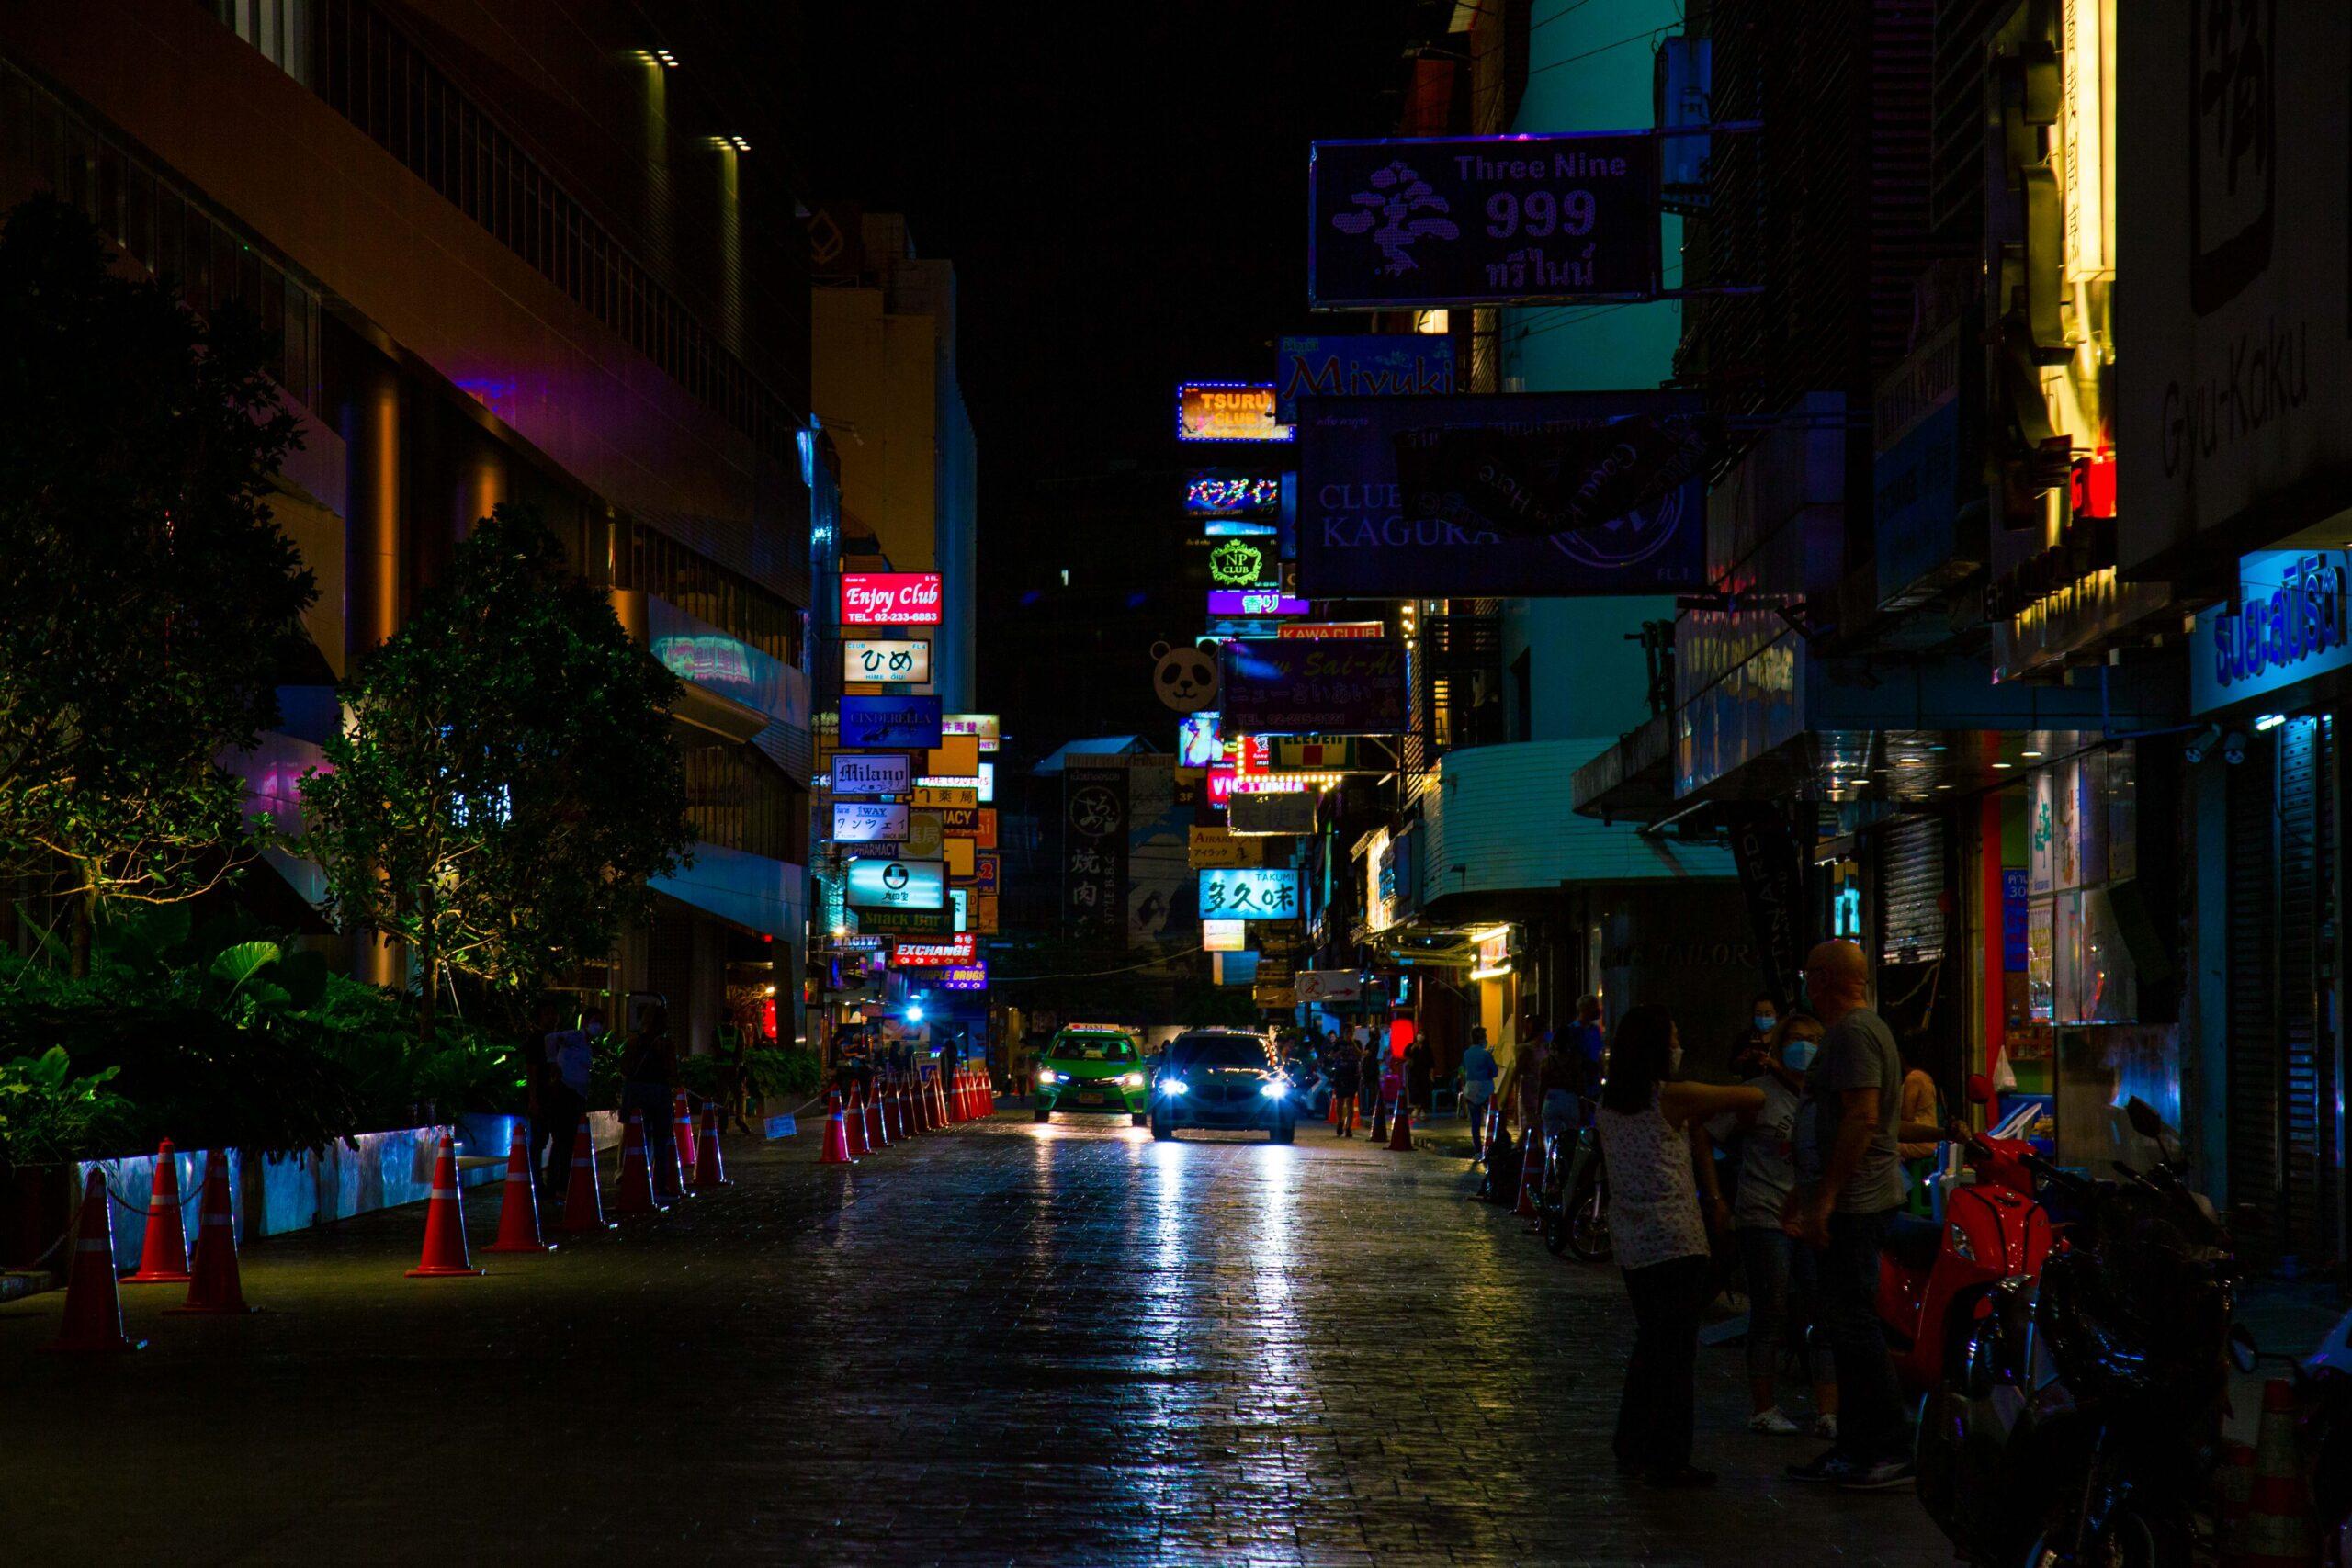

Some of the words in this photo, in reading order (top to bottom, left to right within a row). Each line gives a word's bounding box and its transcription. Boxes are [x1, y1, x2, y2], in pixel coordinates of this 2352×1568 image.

[1454, 155, 1545, 182] Three
[1555, 152, 1627, 179] Nine
[1486, 189, 1597, 240] 999
[1485, 243, 1596, 288] ทรีไนน์
[1282, 355, 1453, 400] Miyuki
[1201, 393, 1269, 410] TSURU
[1214, 412, 1256, 425] CLUB
[1226, 554, 1248, 566] NP
[846, 588, 895, 613] Enjoy
[900, 583, 939, 604] Club
[848, 613, 872, 622] TEL.
[861, 649, 912, 671] ひめ
[851, 711, 933, 724] CINDERELLA
[839, 764, 904, 781] Milano
[939, 790, 973, 803] 薬局
[1179, 793, 1193, 801] 3F
[944, 810, 972, 824] ACY
[854, 843, 898, 856] PHARMACY
[1193, 849, 1227, 857] アイラック
[1071, 848, 1101, 907] 焼肉
[1255, 873, 1295, 882] TAKUMI
[1204, 880, 1295, 913] 多久味
[865, 910, 909, 926] Snack
[897, 944, 972, 956] EXCHANGE
[1657, 943, 1756, 969] TAILOR
